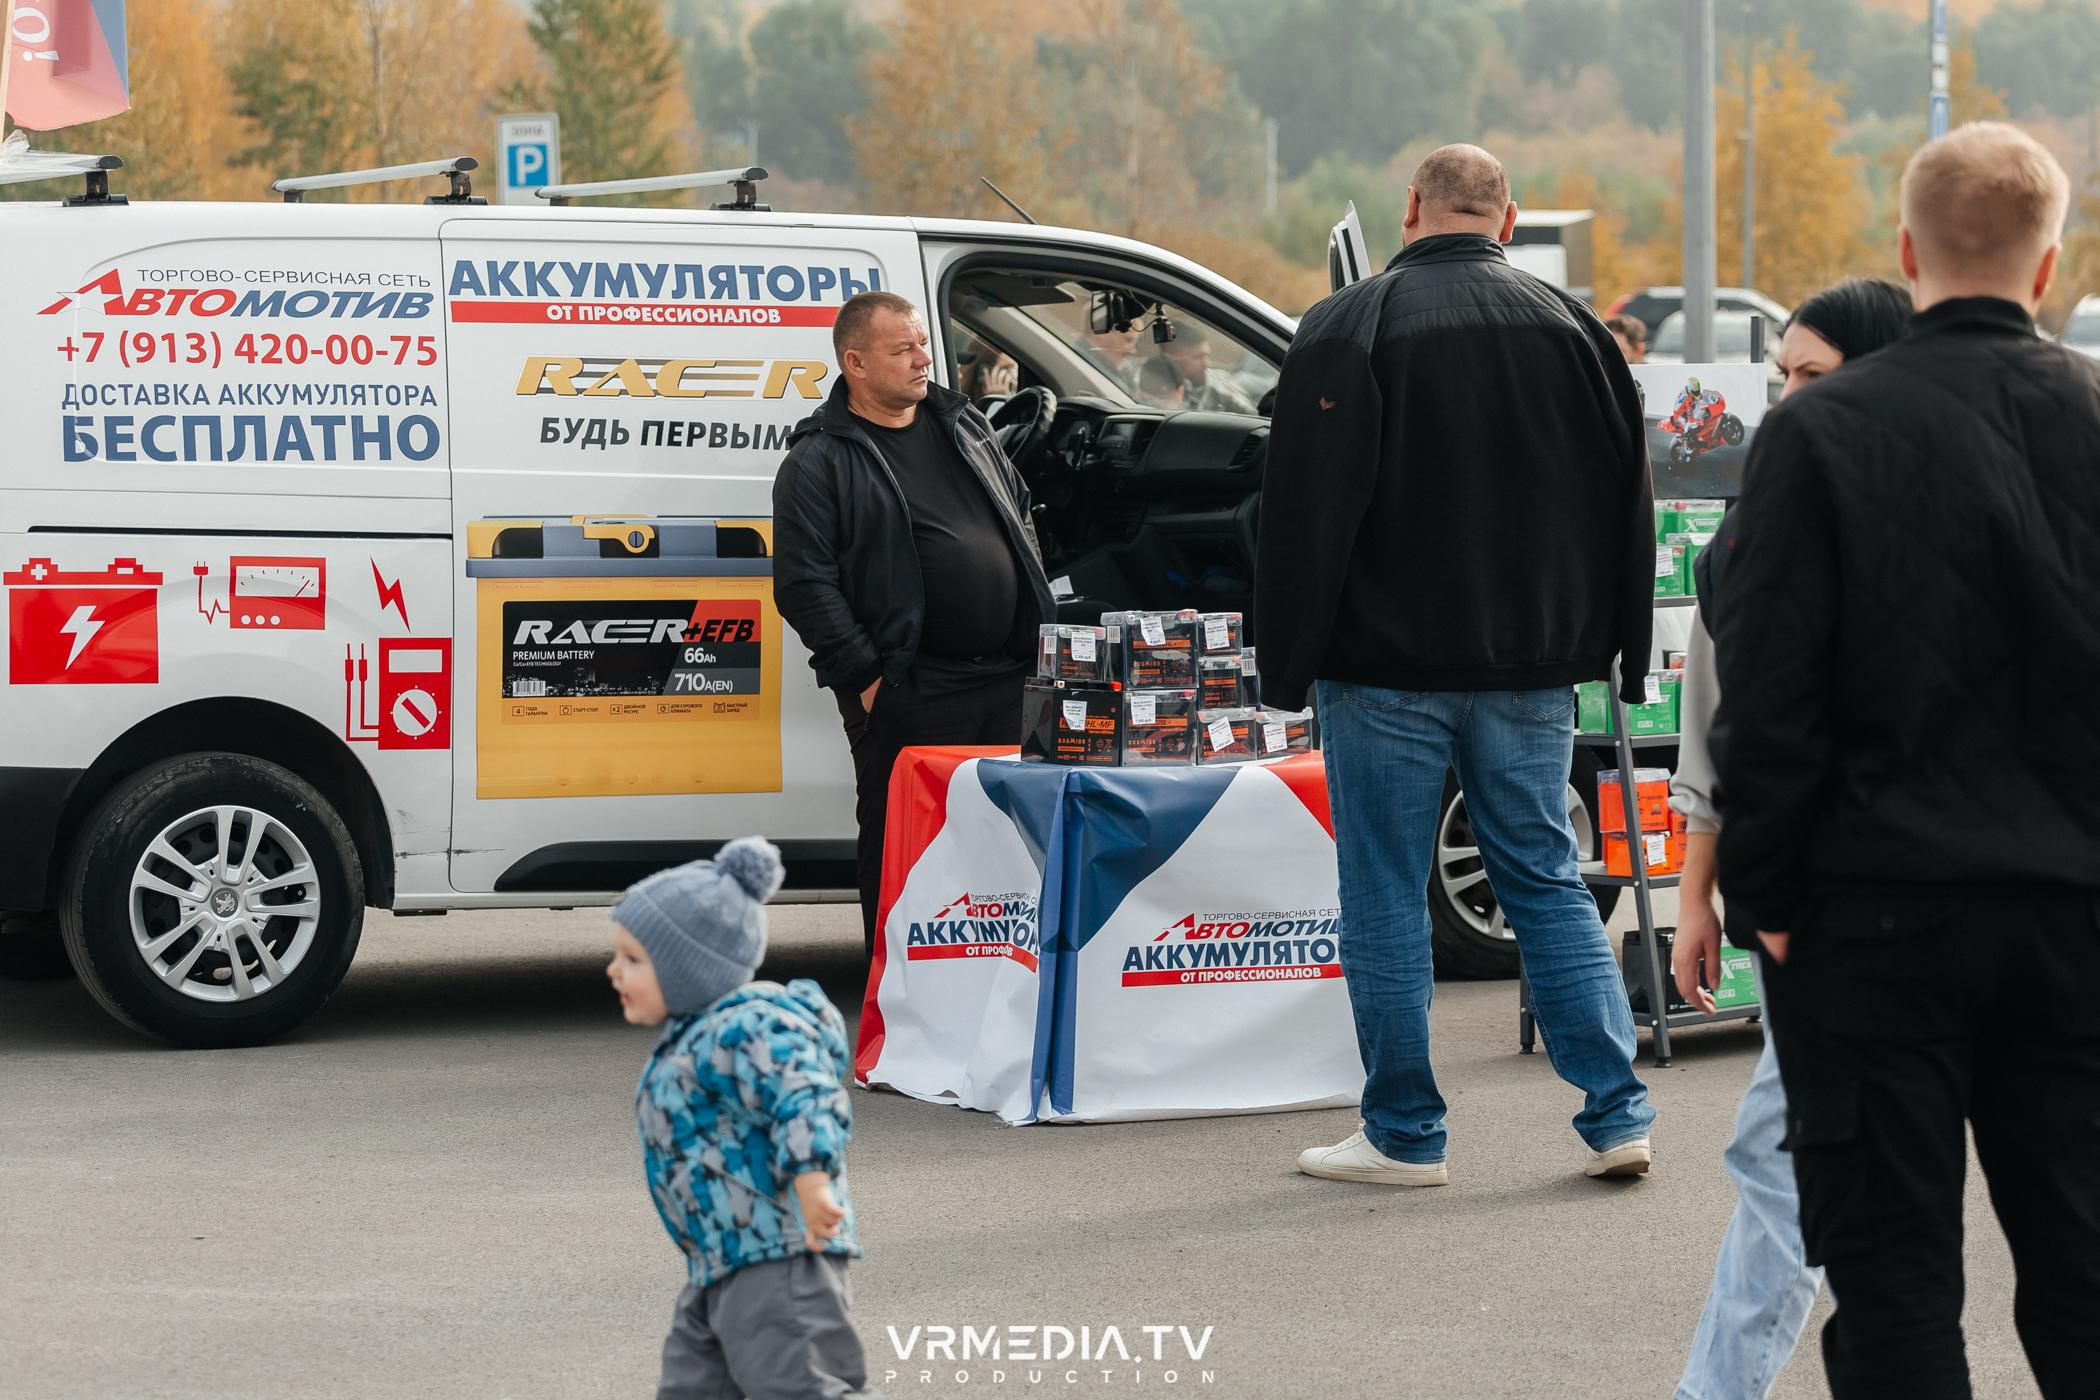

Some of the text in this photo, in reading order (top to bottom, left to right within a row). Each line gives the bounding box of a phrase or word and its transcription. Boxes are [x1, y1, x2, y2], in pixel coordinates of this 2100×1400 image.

[137, 269, 431, 288] ТОРГОВО-СЕРВИСНАЯ СЕТЬ
[448, 260, 881, 302] АККУМУЛЯТОРЫ
[546, 304, 781, 324] ОТ ПРОФЕССИОНАЛОВ
[57, 330, 438, 368] +7 (913) 420-00-75
[515, 355, 829, 399] RACER
[61, 383, 438, 411] ДОСТАВКА АККУМУЛЯТОРА
[62, 414, 440, 462] БЕСПЛАТНО
[540, 417, 630, 450] БУДЬ
[512, 650, 595, 661] PREMIUM BATTERY
[1203, 908, 1341, 921] ТОРГОВО-СЕРВИСНАЯ СЕТ
[965, 946, 980, 956] ОТ
[1122, 938, 1341, 972] АККУМУЛЯТО
[1180, 967, 1322, 983] ОТ ПРОФЕССИОНАЛОВ
